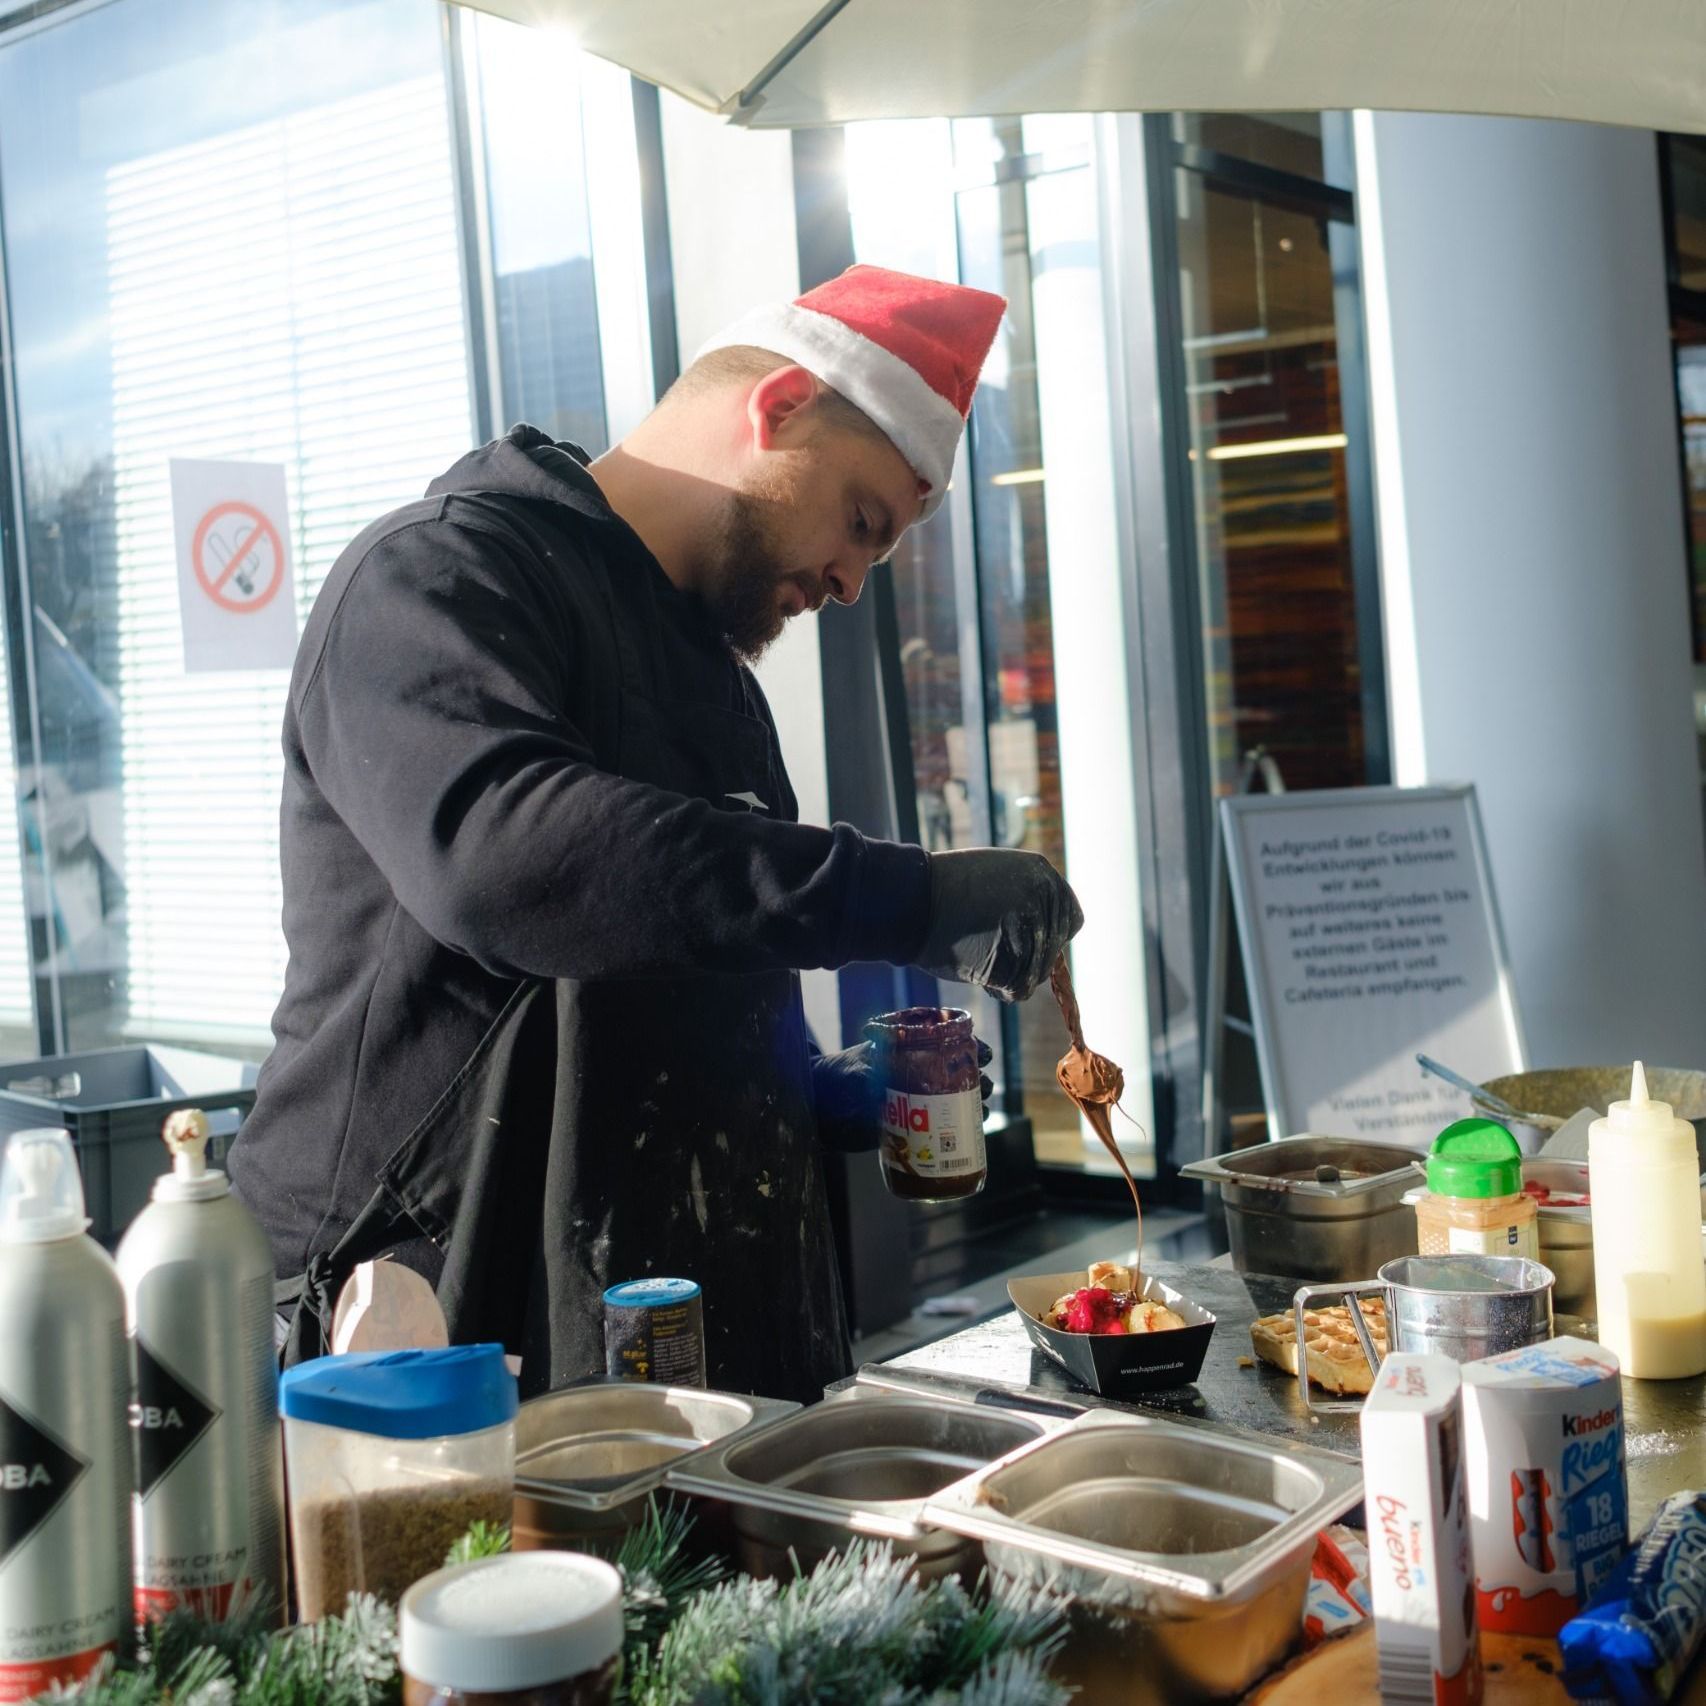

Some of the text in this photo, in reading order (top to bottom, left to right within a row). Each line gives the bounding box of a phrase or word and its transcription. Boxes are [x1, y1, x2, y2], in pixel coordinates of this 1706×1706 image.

[1260, 827, 1450, 857] Aufgrund der Covid-19
[1262, 848, 1457, 878] Entwicklungen können
[1320, 877, 1381, 893] wir aus
[1265, 888, 1470, 918] Präventionsgründen bis
[1289, 913, 1443, 939] auf weiteres keine
[1293, 932, 1448, 960] externen Gäste im
[1305, 955, 1438, 979] Restaurant und
[1284, 984, 1363, 1004] Cafeteria
[1330, 1096, 1382, 1113] Vielen
[1387, 1090, 1431, 1107] Dank
[1120, 1362, 1184, 1375] www.happenrad.de
[0, 1464, 51, 1489] BA
[1587, 1492, 1613, 1527] 18
[1376, 1495, 1412, 1590] bueno
[1575, 1523, 1625, 1552] RIEGEL
[193, 1547, 247, 1568] CREAM
[6, 1607, 115, 1640] DAIRY CREAM
